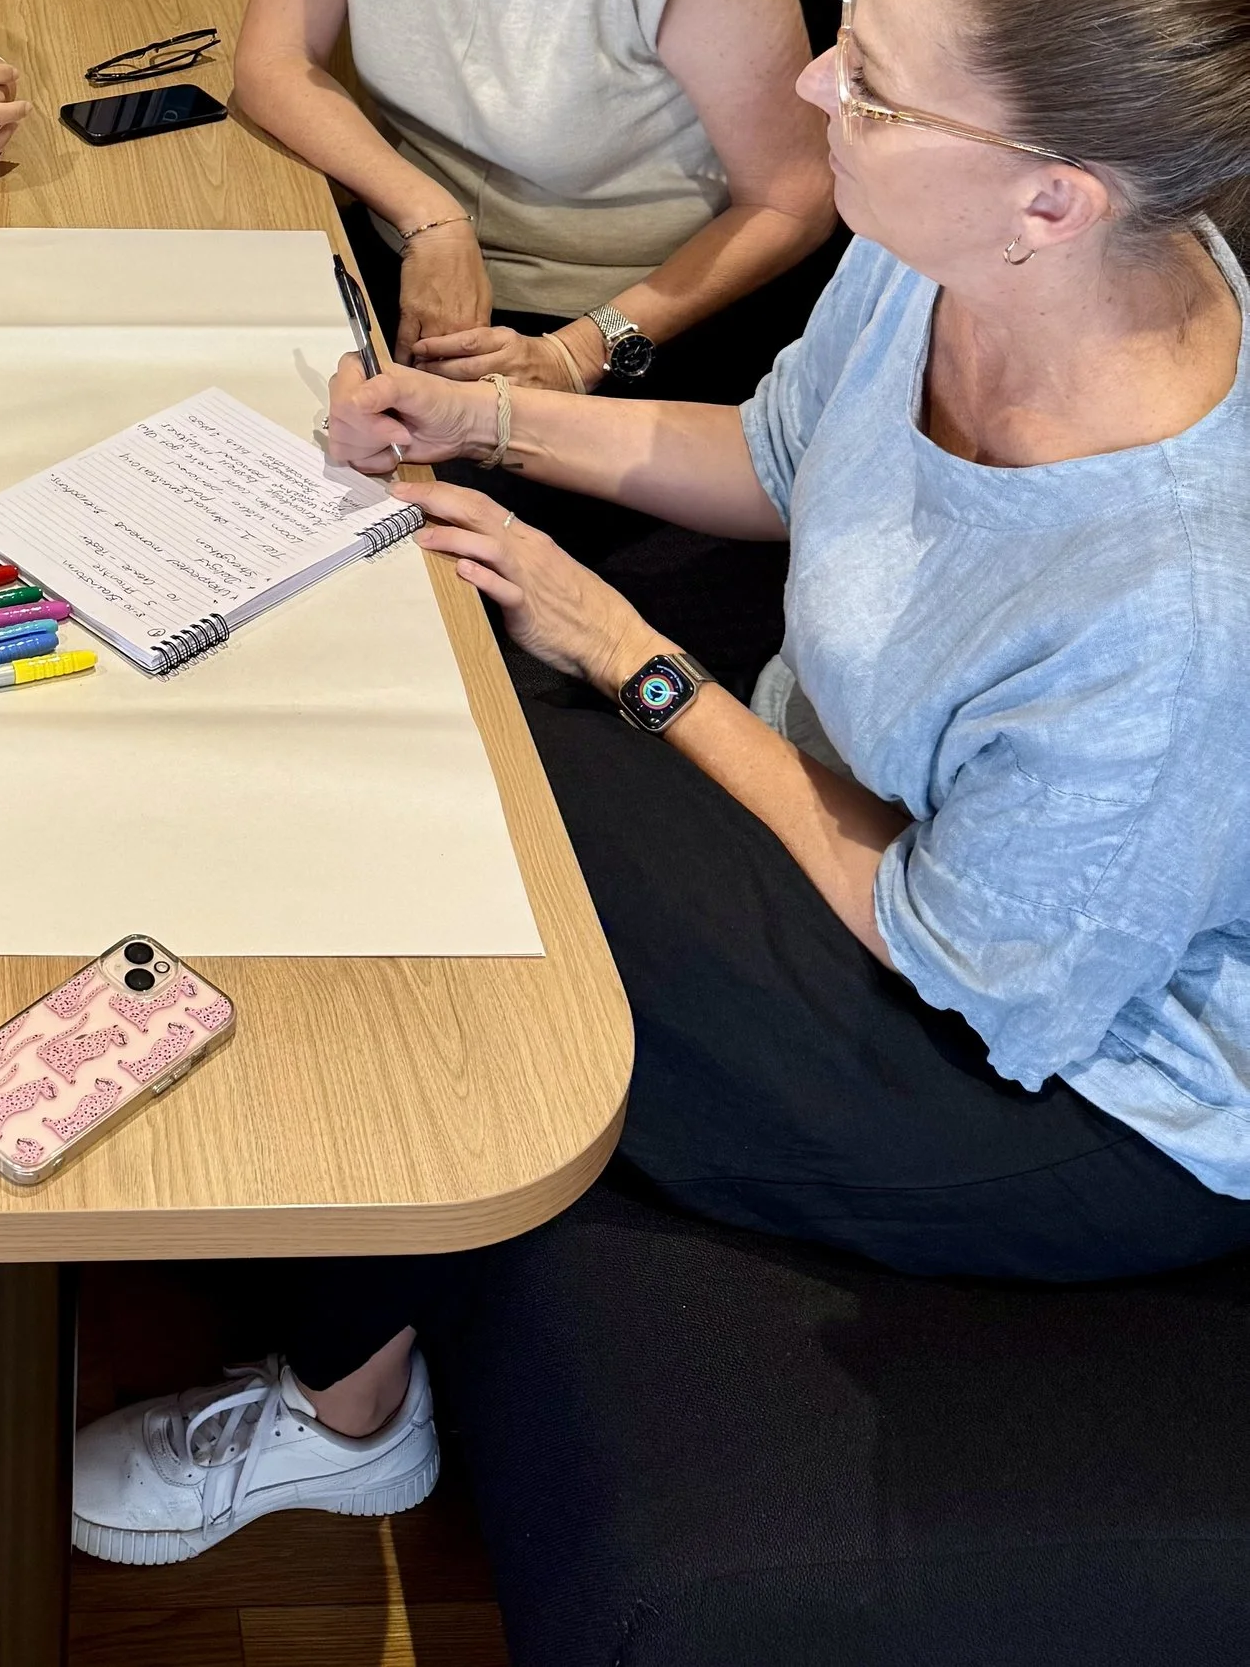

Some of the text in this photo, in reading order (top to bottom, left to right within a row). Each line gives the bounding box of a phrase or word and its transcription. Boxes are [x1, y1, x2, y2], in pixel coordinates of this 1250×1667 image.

[113, 522, 166, 552] moments
[272, 524, 304, 543] Loom
[63, 560, 123, 602] Brainstorm
[166, 556, 231, 596] Unexpected
[167, 593, 182, 601] 10
